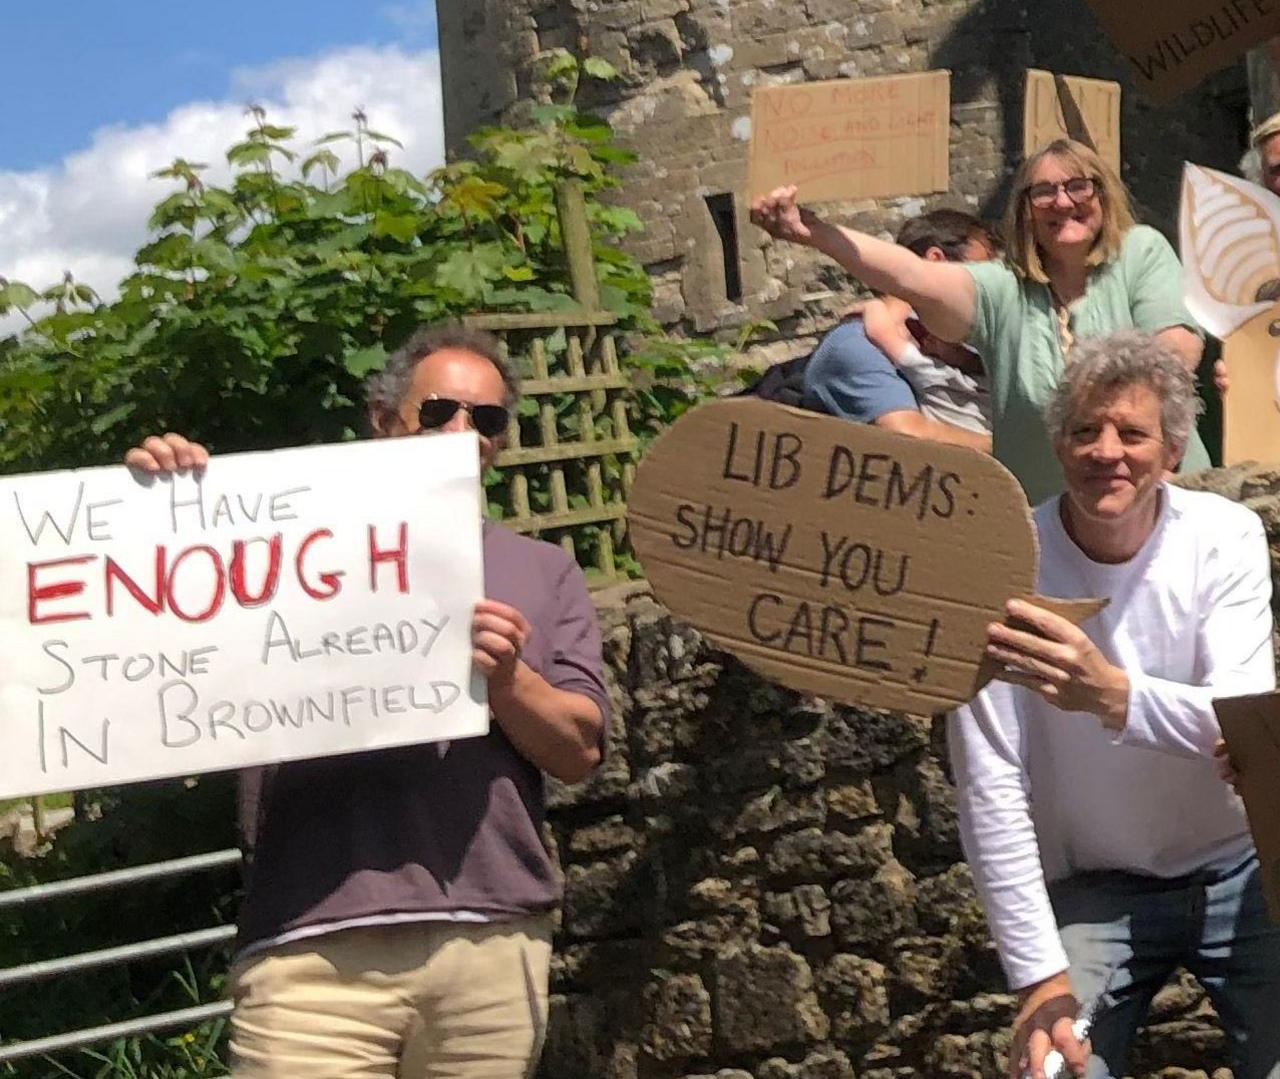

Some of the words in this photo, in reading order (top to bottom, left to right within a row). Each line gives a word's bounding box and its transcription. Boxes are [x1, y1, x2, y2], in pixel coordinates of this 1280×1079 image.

[15, 482, 124, 546] WE
[171, 472, 312, 534] HAVE
[723, 422, 803, 490] LIB
[825, 444, 980, 522] DEMS:
[26, 522, 411, 626] ENOUGH
[671, 504, 792, 574] SHOW
[820, 531, 911, 597] YOU
[38, 639, 219, 696] STONE
[261, 610, 450, 665] ALREADY
[36, 699, 112, 772] IN
[157, 680, 461, 749] BROWNFIELD
